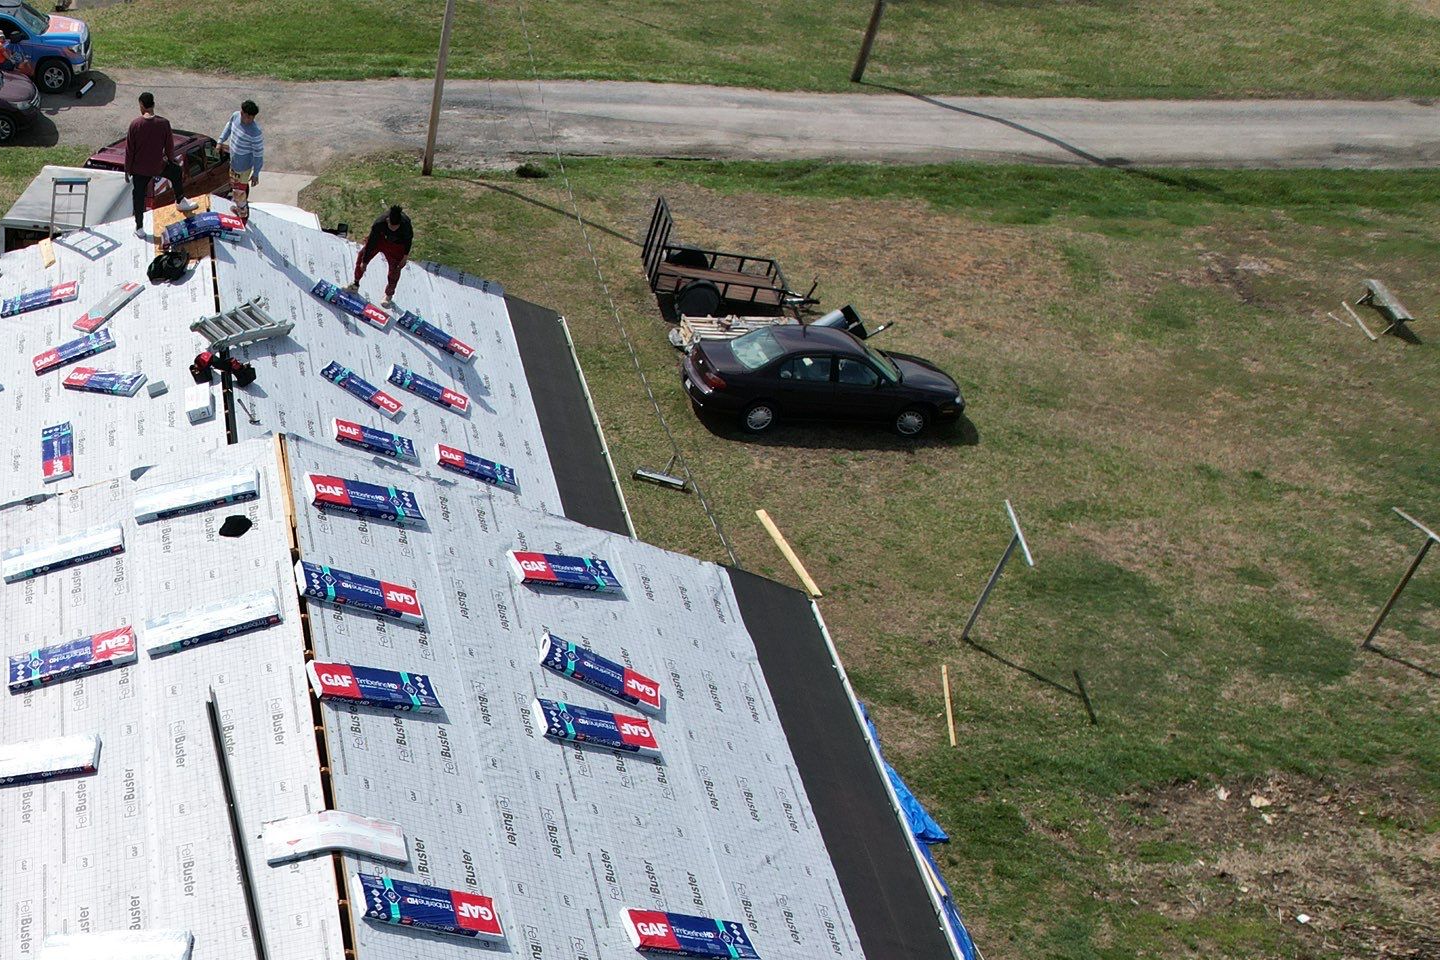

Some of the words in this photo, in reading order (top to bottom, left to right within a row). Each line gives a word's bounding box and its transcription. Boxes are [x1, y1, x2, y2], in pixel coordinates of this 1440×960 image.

[366, 308, 386, 324] GAF
[452, 340, 470, 356] GAF
[377, 395, 398, 412] GAF
[445, 389, 466, 405] GAF
[339, 425, 360, 435] GAF
[441, 450, 462, 461] GAF
[316, 483, 344, 496] GAF
[521, 560, 547, 572] GAF
[387, 590, 416, 605] GAF
[95, 633, 131, 653] GAF
[321, 673, 352, 686] GAF
[627, 678, 656, 697] GAF
[475, 681, 491, 726] FeltBuster
[271, 698, 285, 745] FeltBuster
[621, 721, 650, 738] GAF
[174, 720, 185, 768] FeltBuster
[439, 726, 454, 775] FeltBuster
[544, 807, 561, 858] FeltBuster
[184, 843, 195, 897] FeltBuster
[459, 903, 492, 920] GAF
[638, 922, 669, 938] GAF
